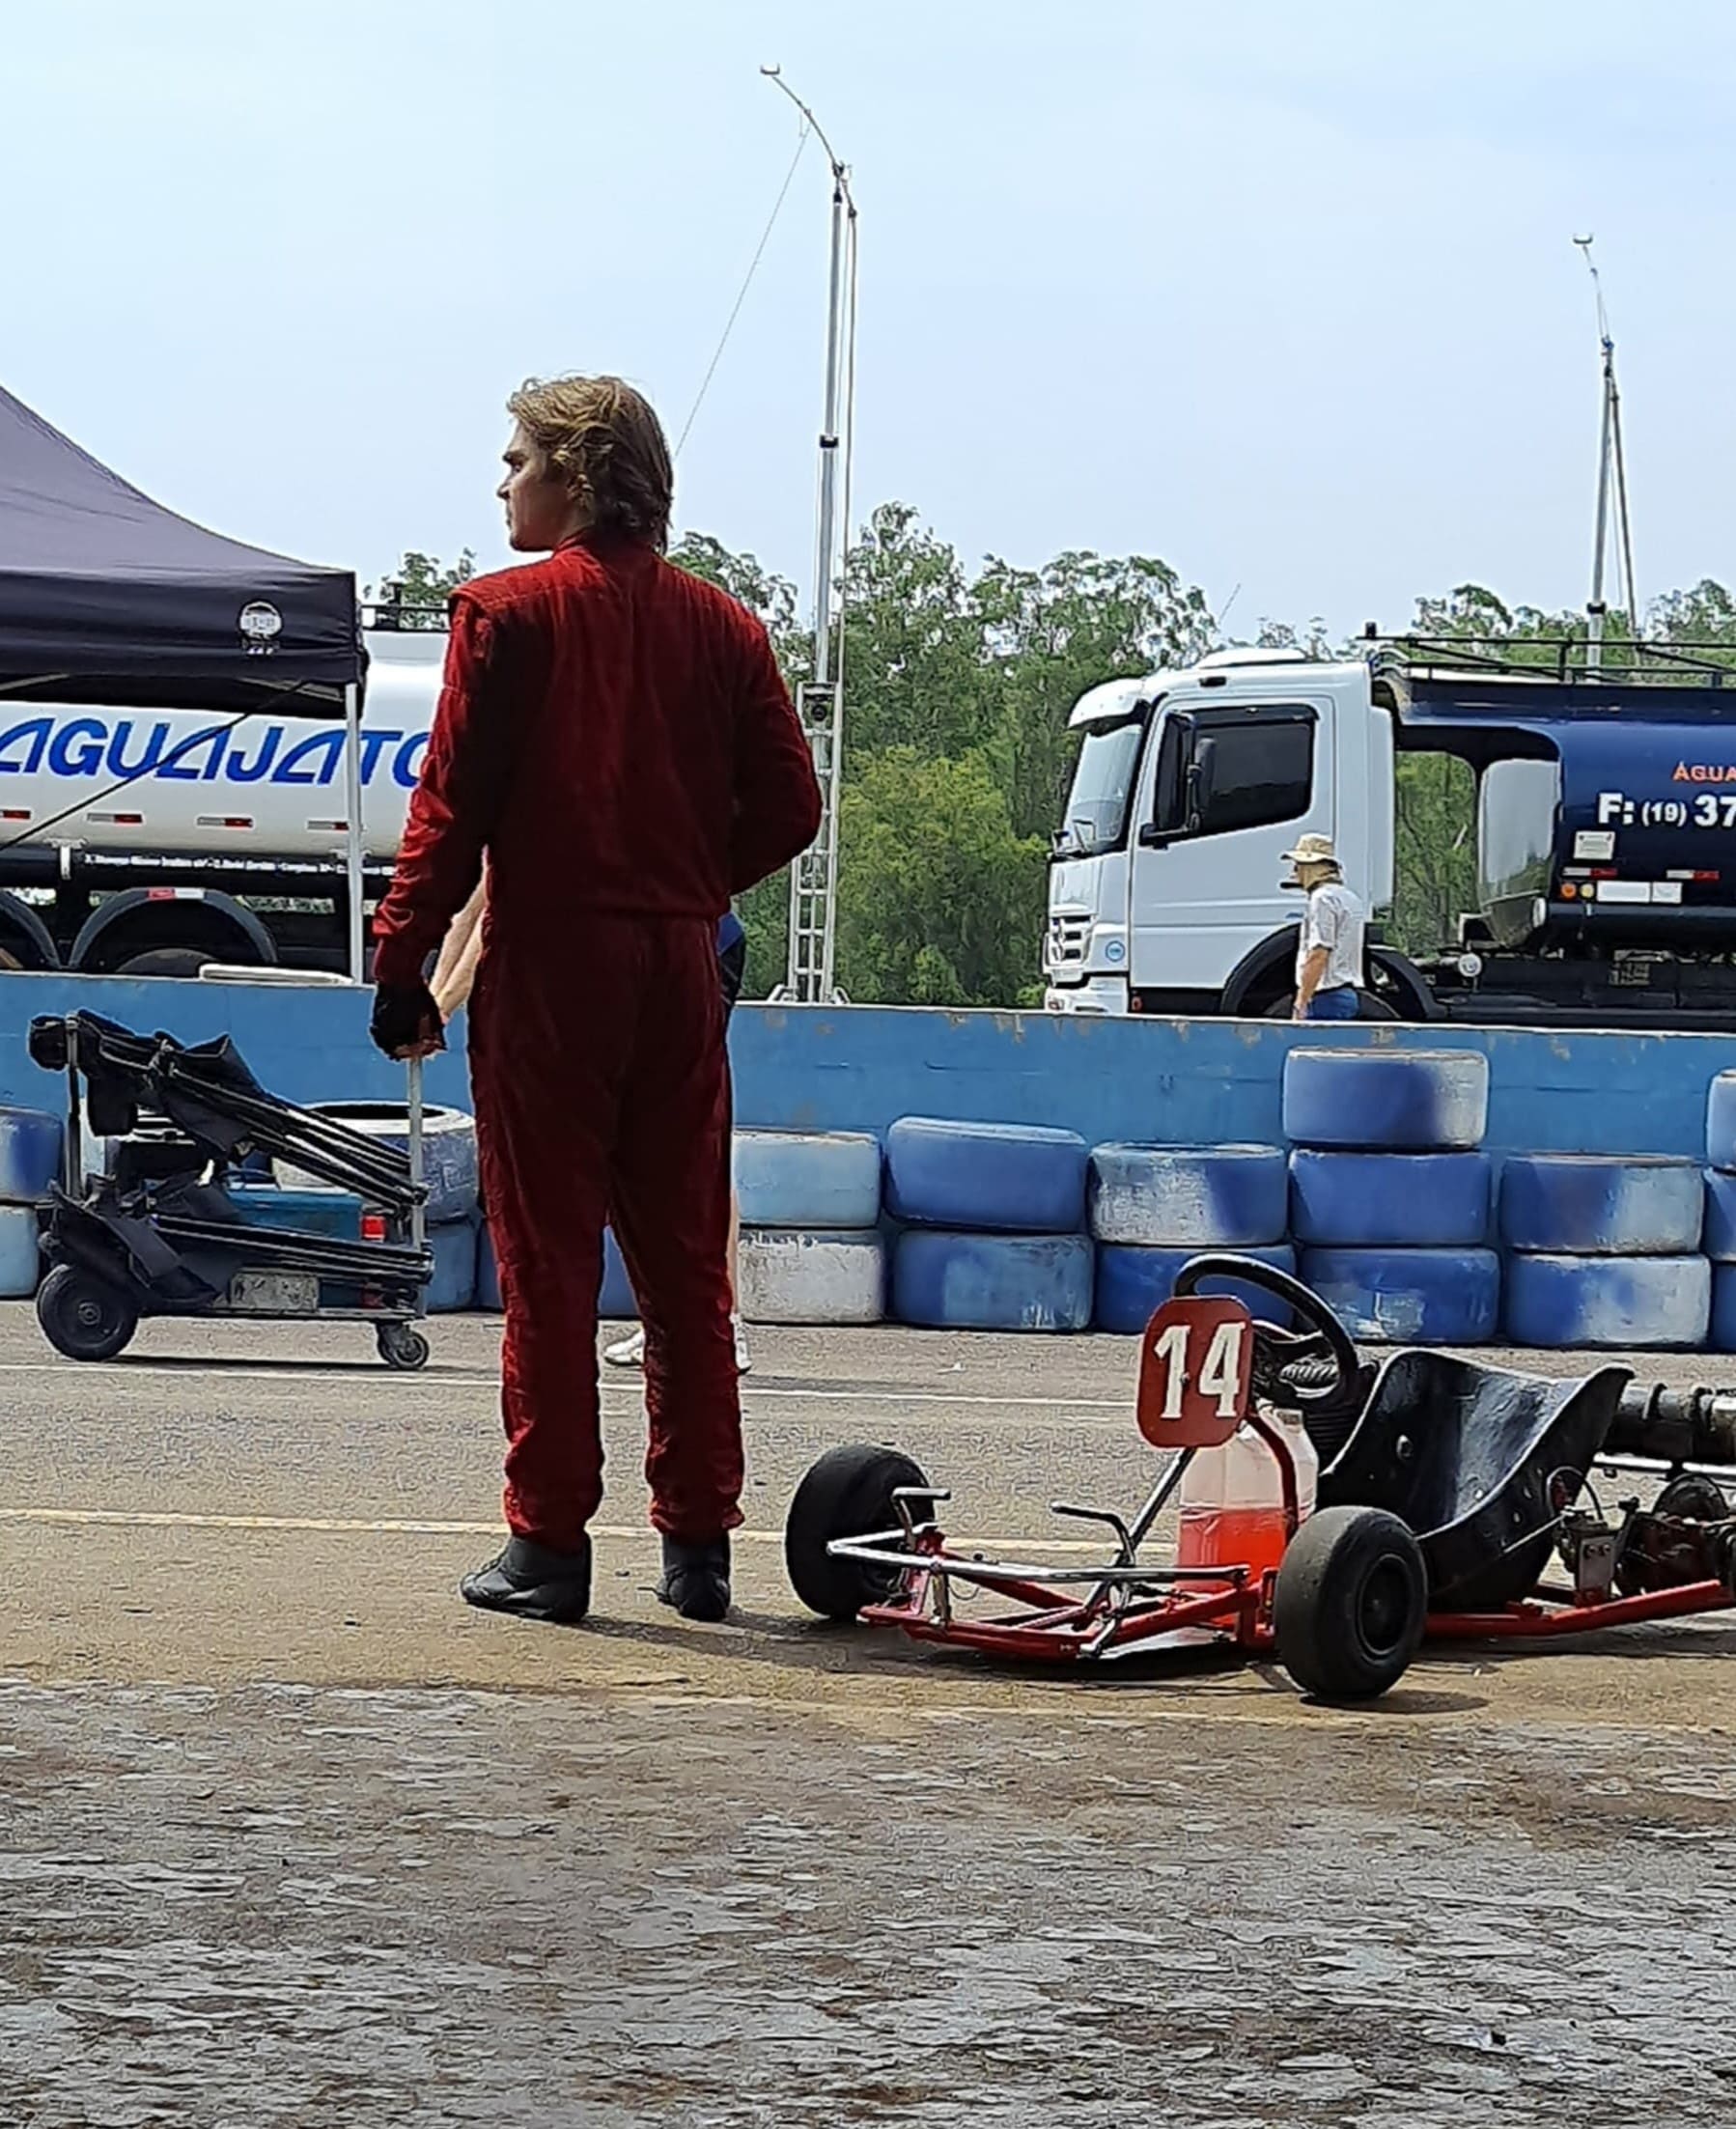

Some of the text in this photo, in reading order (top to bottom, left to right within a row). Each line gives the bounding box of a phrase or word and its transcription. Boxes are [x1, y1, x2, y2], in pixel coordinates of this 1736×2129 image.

[1598, 793, 1736, 826] F: (19) 37
[1154, 1321, 1246, 1418] 14
